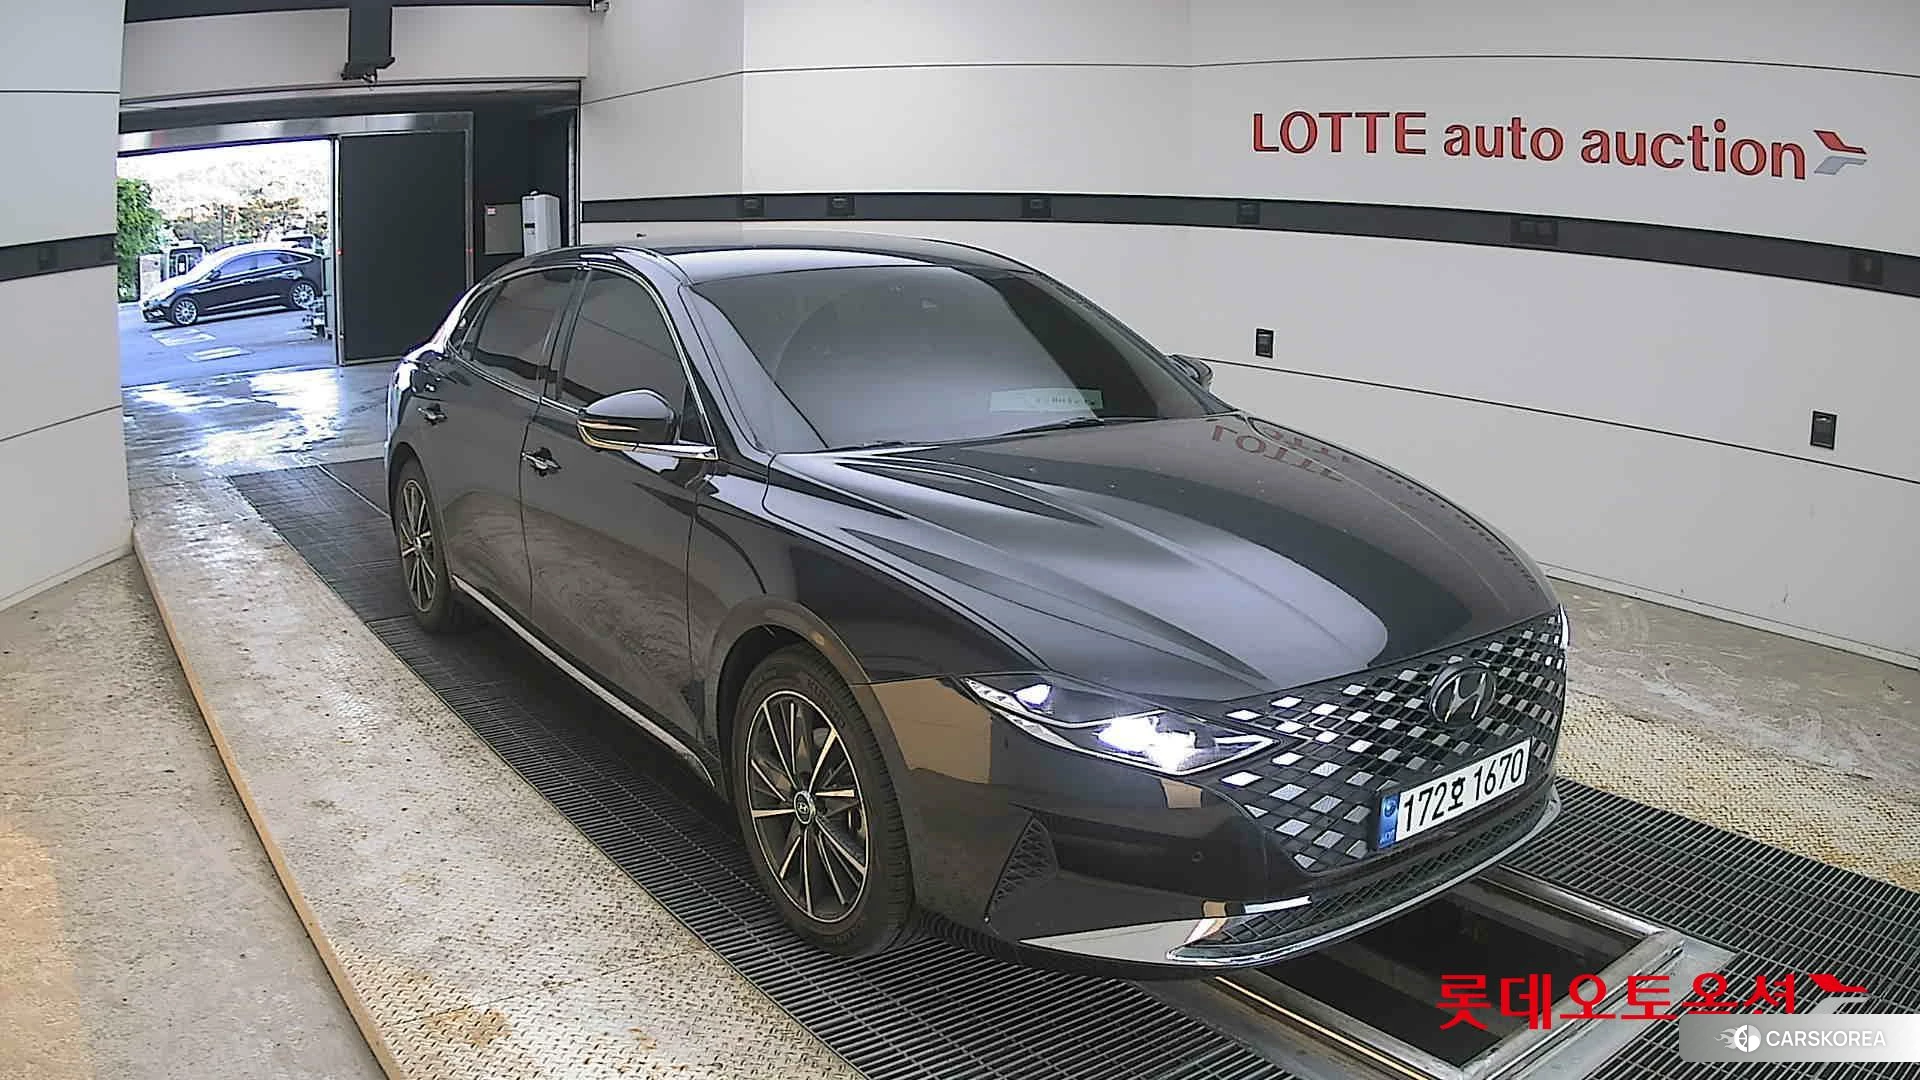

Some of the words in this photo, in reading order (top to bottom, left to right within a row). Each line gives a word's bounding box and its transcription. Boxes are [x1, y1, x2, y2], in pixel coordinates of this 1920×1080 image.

[1252, 111, 1427, 155] LOTTE
[1444, 117, 1564, 161] auto
[1581, 118, 1806, 180] auction
[1404, 777, 1466, 832] 172호
[1473, 748, 1524, 801] 1670
